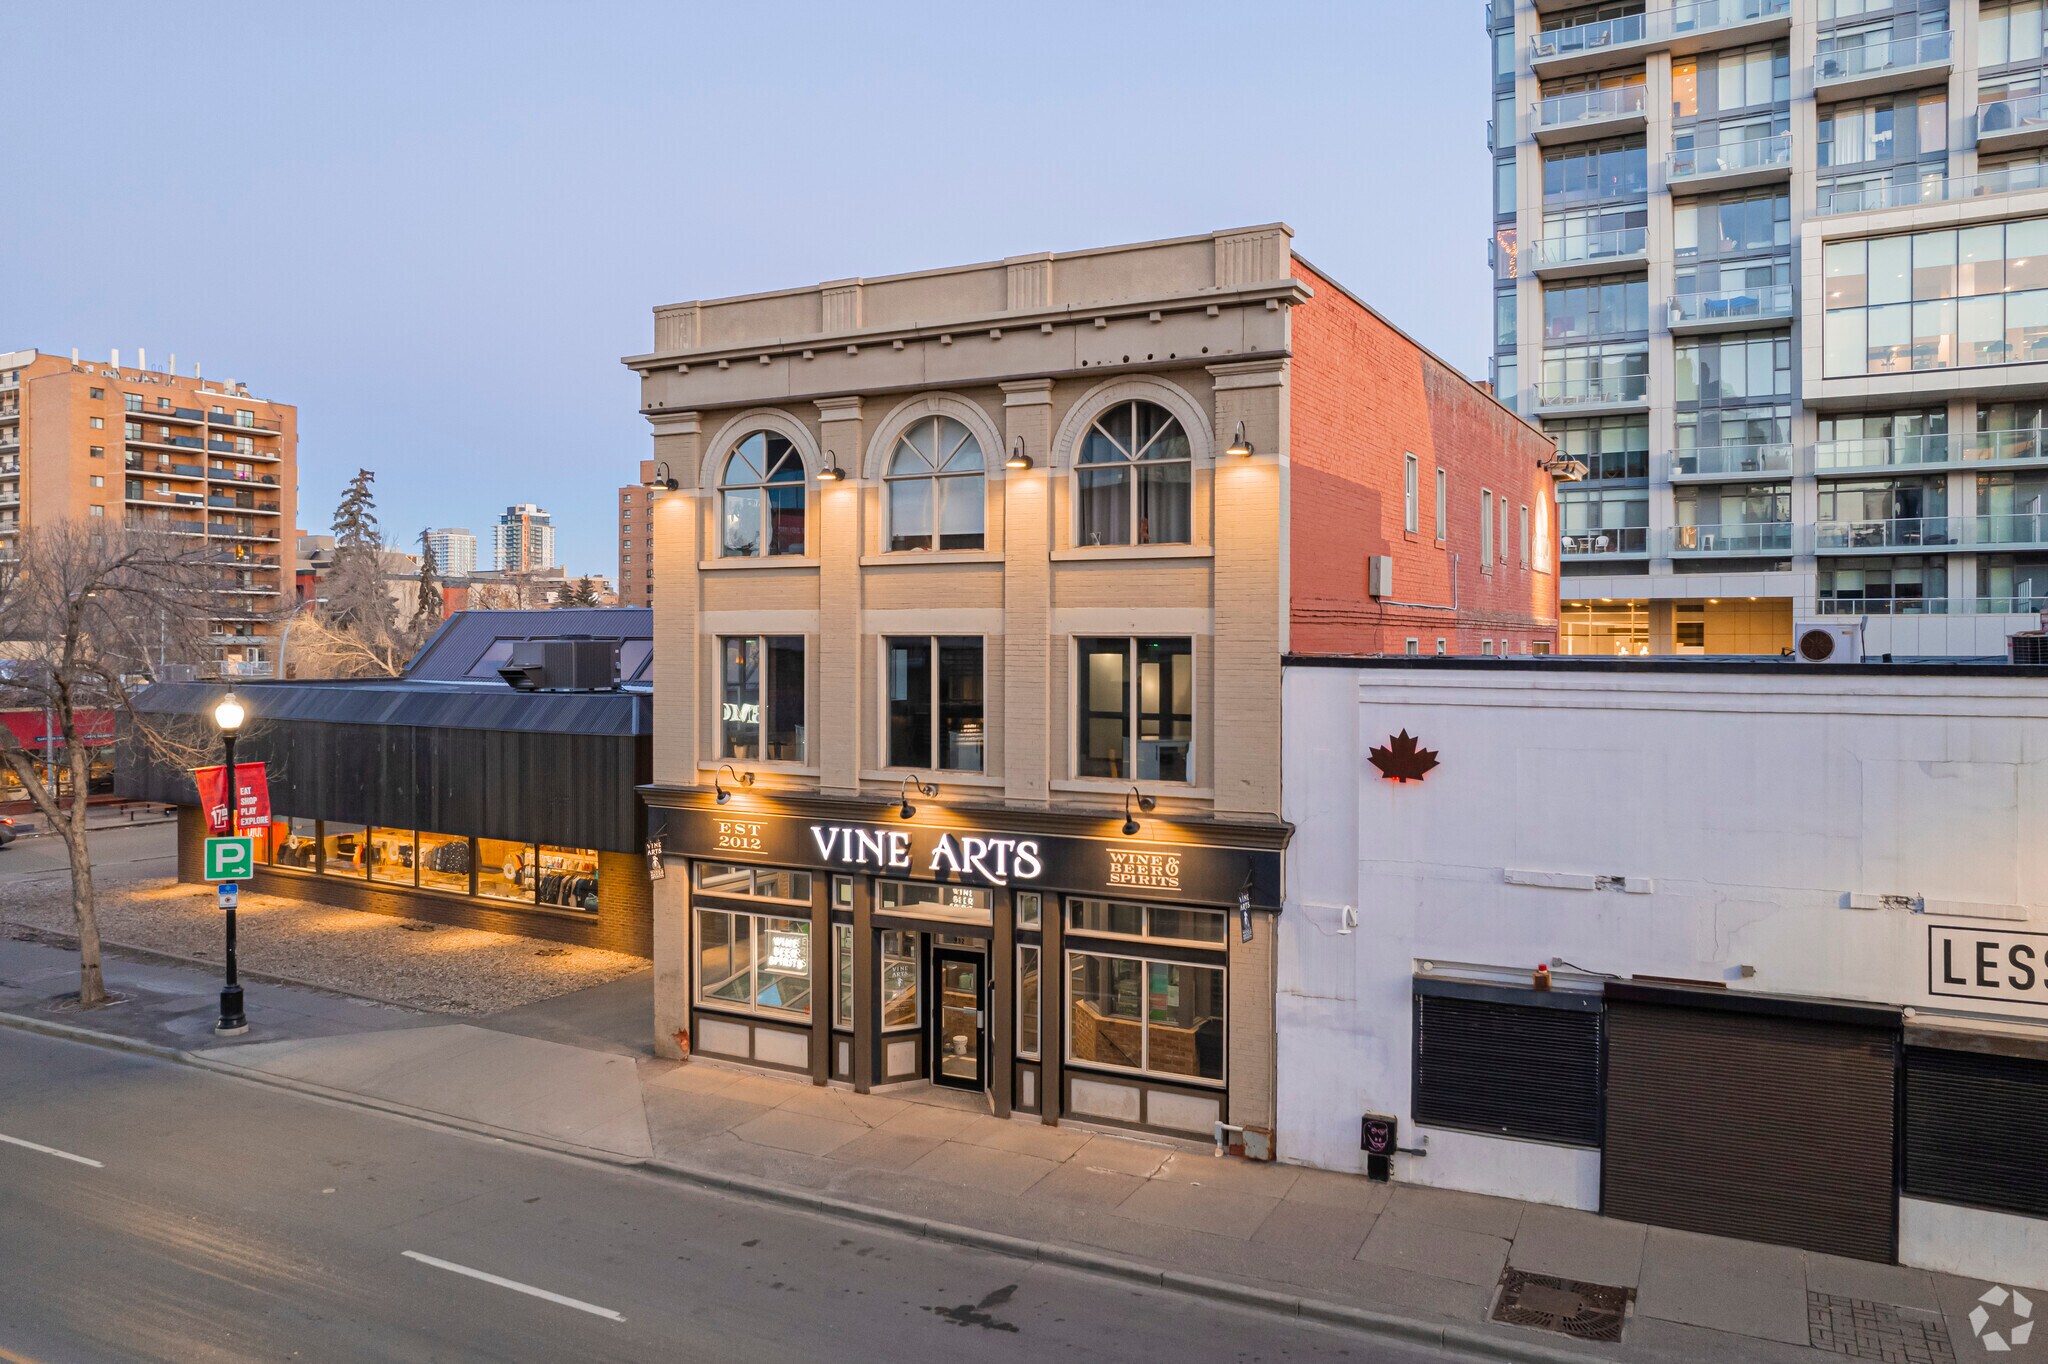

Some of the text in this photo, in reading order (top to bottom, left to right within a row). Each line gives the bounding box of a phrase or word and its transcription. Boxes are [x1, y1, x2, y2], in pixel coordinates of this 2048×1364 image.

[240, 787, 251, 795] EAT
[241, 797, 257, 805] SHOP
[241, 807, 256, 815] PLAY
[241, 816, 268, 826] EXPLORE
[719, 822, 761, 836] EST
[719, 836, 761, 849] 2012
[216, 843, 245, 872] P
[810, 826, 1042, 886] VINE ARTS
[1110, 852, 1180, 876] WINE &
[1110, 863, 1162, 876] BEER
[1110, 873, 1179, 887] SPIRITS
[1943, 938, 2048, 991] LES
